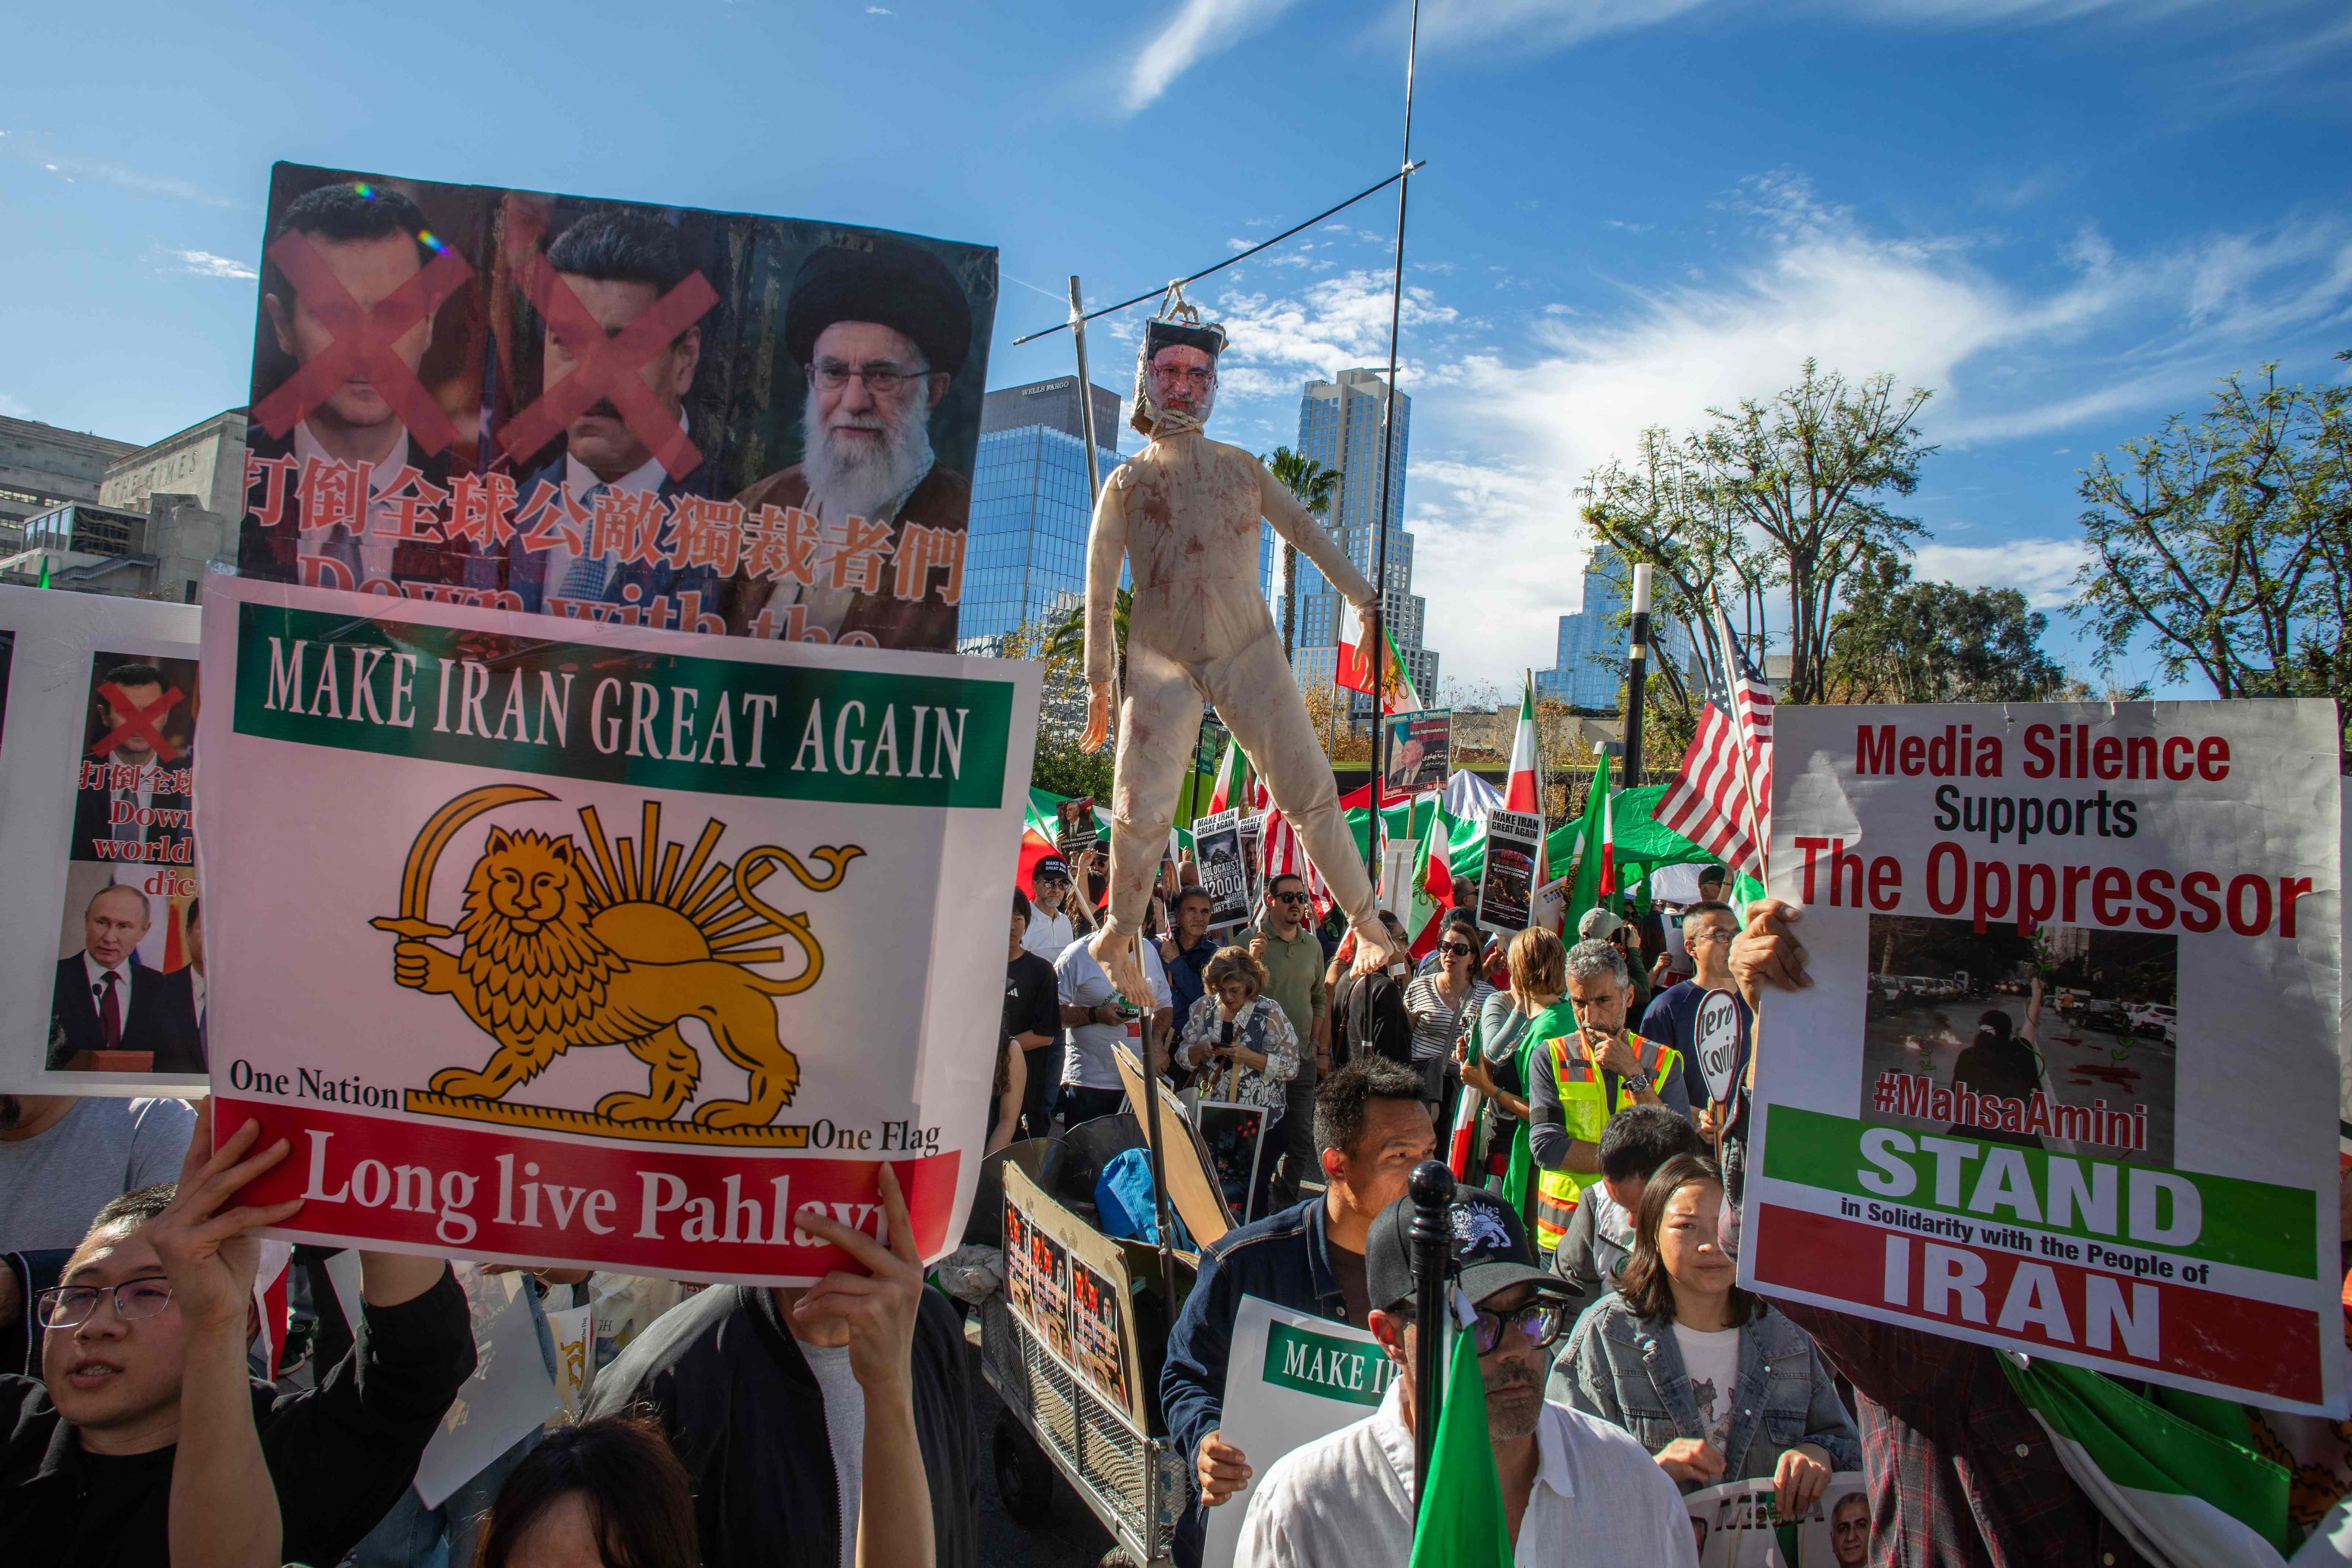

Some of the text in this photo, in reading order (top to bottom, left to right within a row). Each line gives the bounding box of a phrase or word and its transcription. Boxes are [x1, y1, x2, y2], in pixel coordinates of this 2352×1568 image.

[1022, 382, 1069, 396] WELLS FARGO
[145, 451, 197, 490] TIMES
[264, 637, 970, 780] MAKE IRAN GREAT AGAIN
[1424, 710, 1451, 719] Freedom.
[1856, 723, 2230, 781] Media Silence
[1385, 788, 1402, 797] Regime
[1404, 783, 1426, 793] CHANGE
[1197, 809, 1235, 828] MAKE IRAN
[1197, 819, 1235, 836] GREAT AGAIN
[1240, 816, 1257, 826] MAKE
[1240, 823, 1255, 832] GREAT
[1493, 810, 1539, 830] MAKE IRAN
[1934, 784, 2137, 845] Supports
[1492, 821, 1538, 840] GREAT AGAIN
[92, 836, 192, 864] world
[1501, 849, 1524, 862] IRAN
[1202, 860, 1239, 878] HOLOCAUST
[144, 870, 200, 897] dic
[1204, 875, 1242, 898] 12000
[1795, 837, 2312, 938] The Oppressor
[1213, 906, 1222, 914] JAN
[230, 1059, 400, 1110] One Nation
[1873, 1072, 2148, 1151] #MahsaAmini
[811, 1118, 941, 1158] One Flag
[300, 1129, 480, 1244] Long
[493, 1154, 617, 1235] live
[1857, 1127, 2203, 1247] STAND
[1841, 1197, 2209, 1285] in Solidarity with the People of
[1884, 1234, 2161, 1362] IRAN
[1282, 1340, 1365, 1391] MAKE
